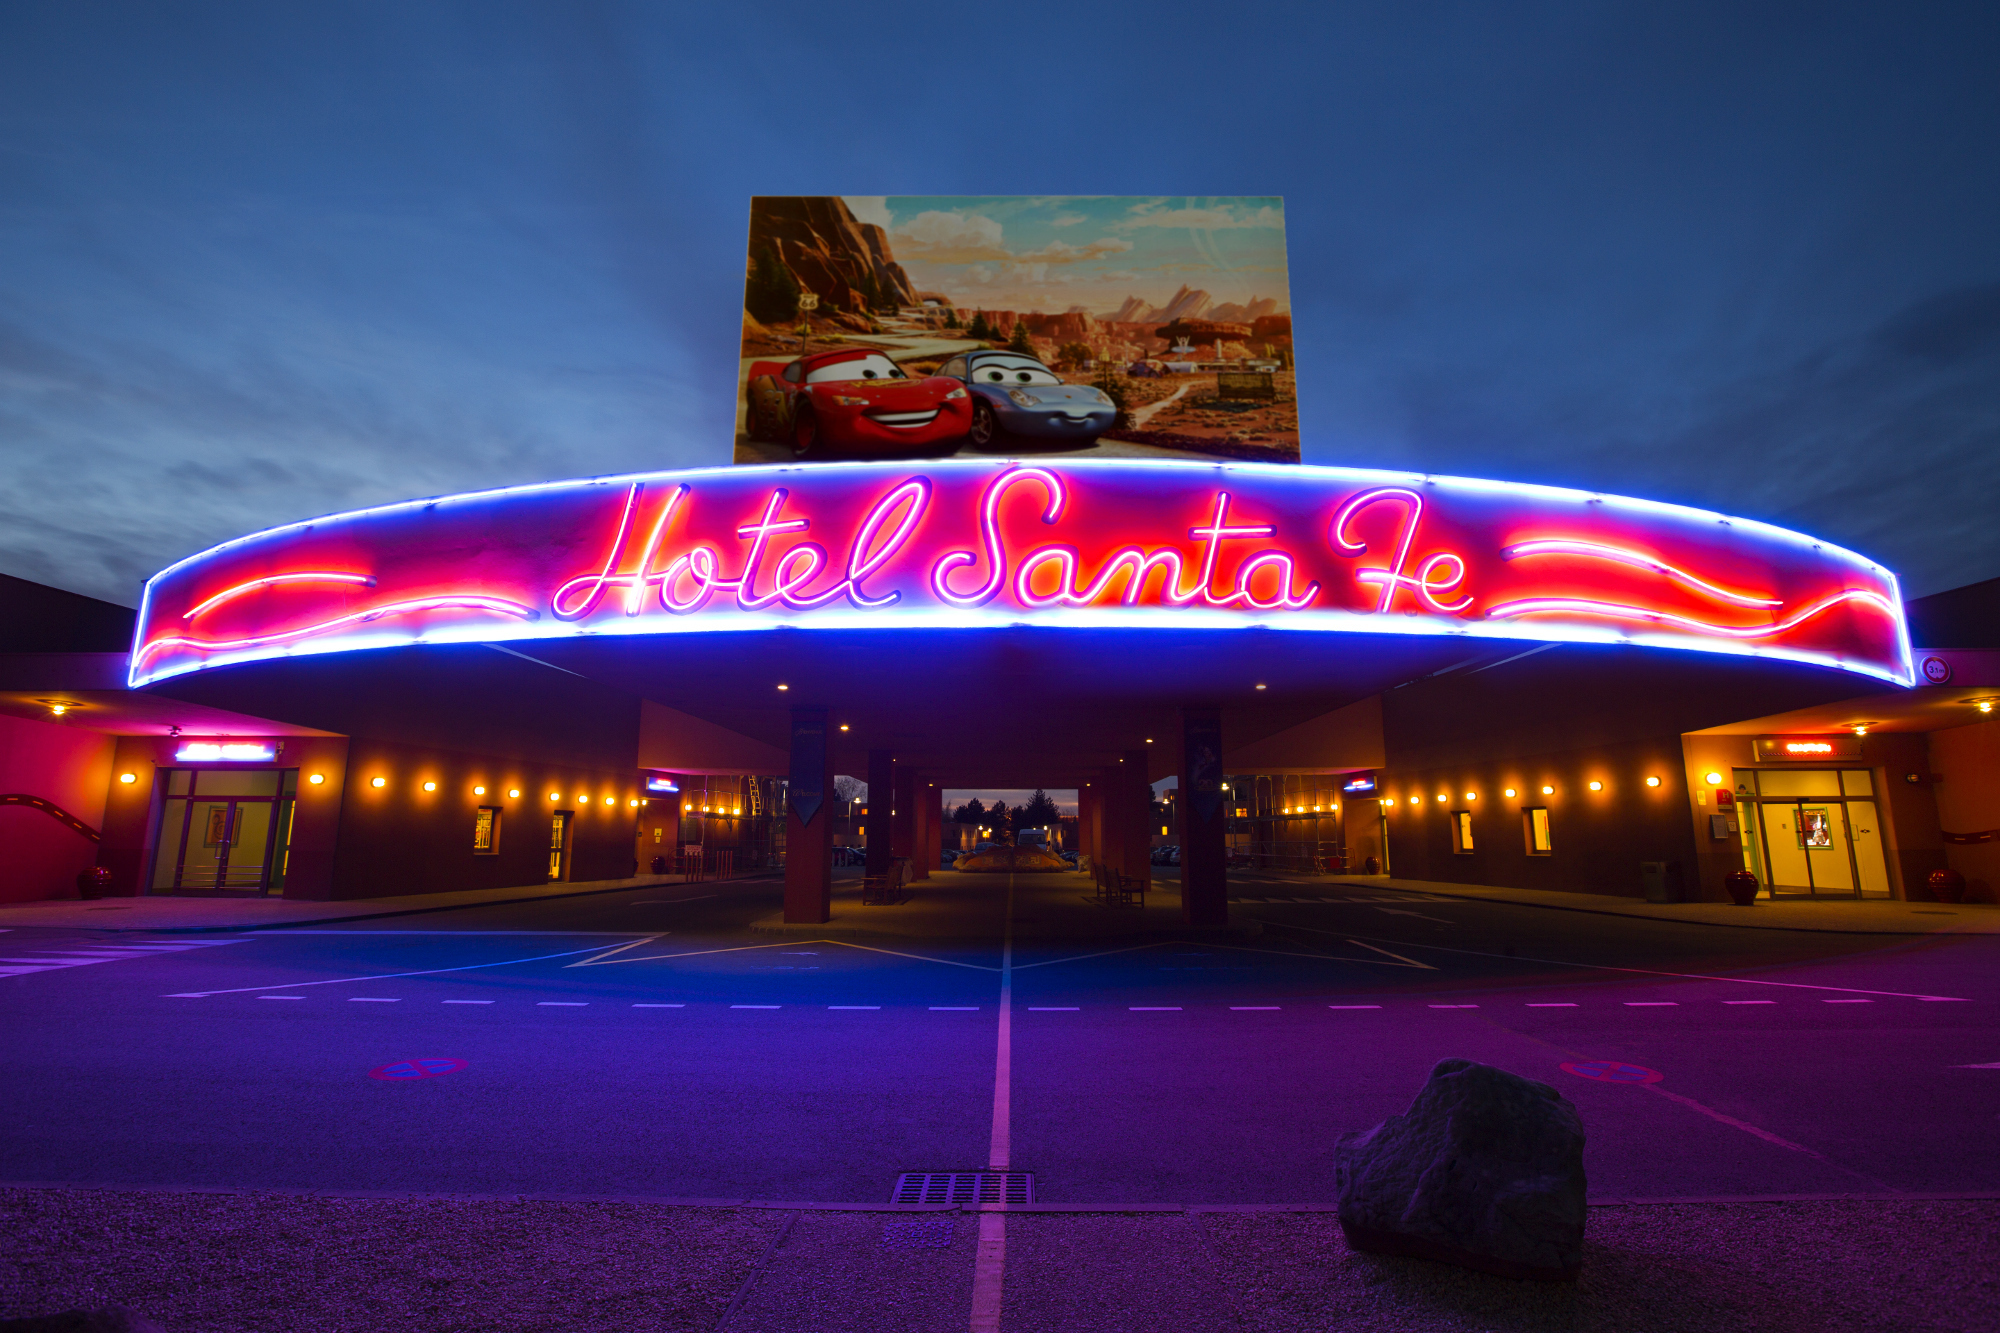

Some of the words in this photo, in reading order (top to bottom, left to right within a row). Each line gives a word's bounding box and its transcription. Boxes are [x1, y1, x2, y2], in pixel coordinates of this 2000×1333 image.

[801, 299, 816, 308] 66
[552, 475, 932, 621] Hotel
[931, 466, 1320, 609] Santa
[1328, 486, 1475, 614] Fe
